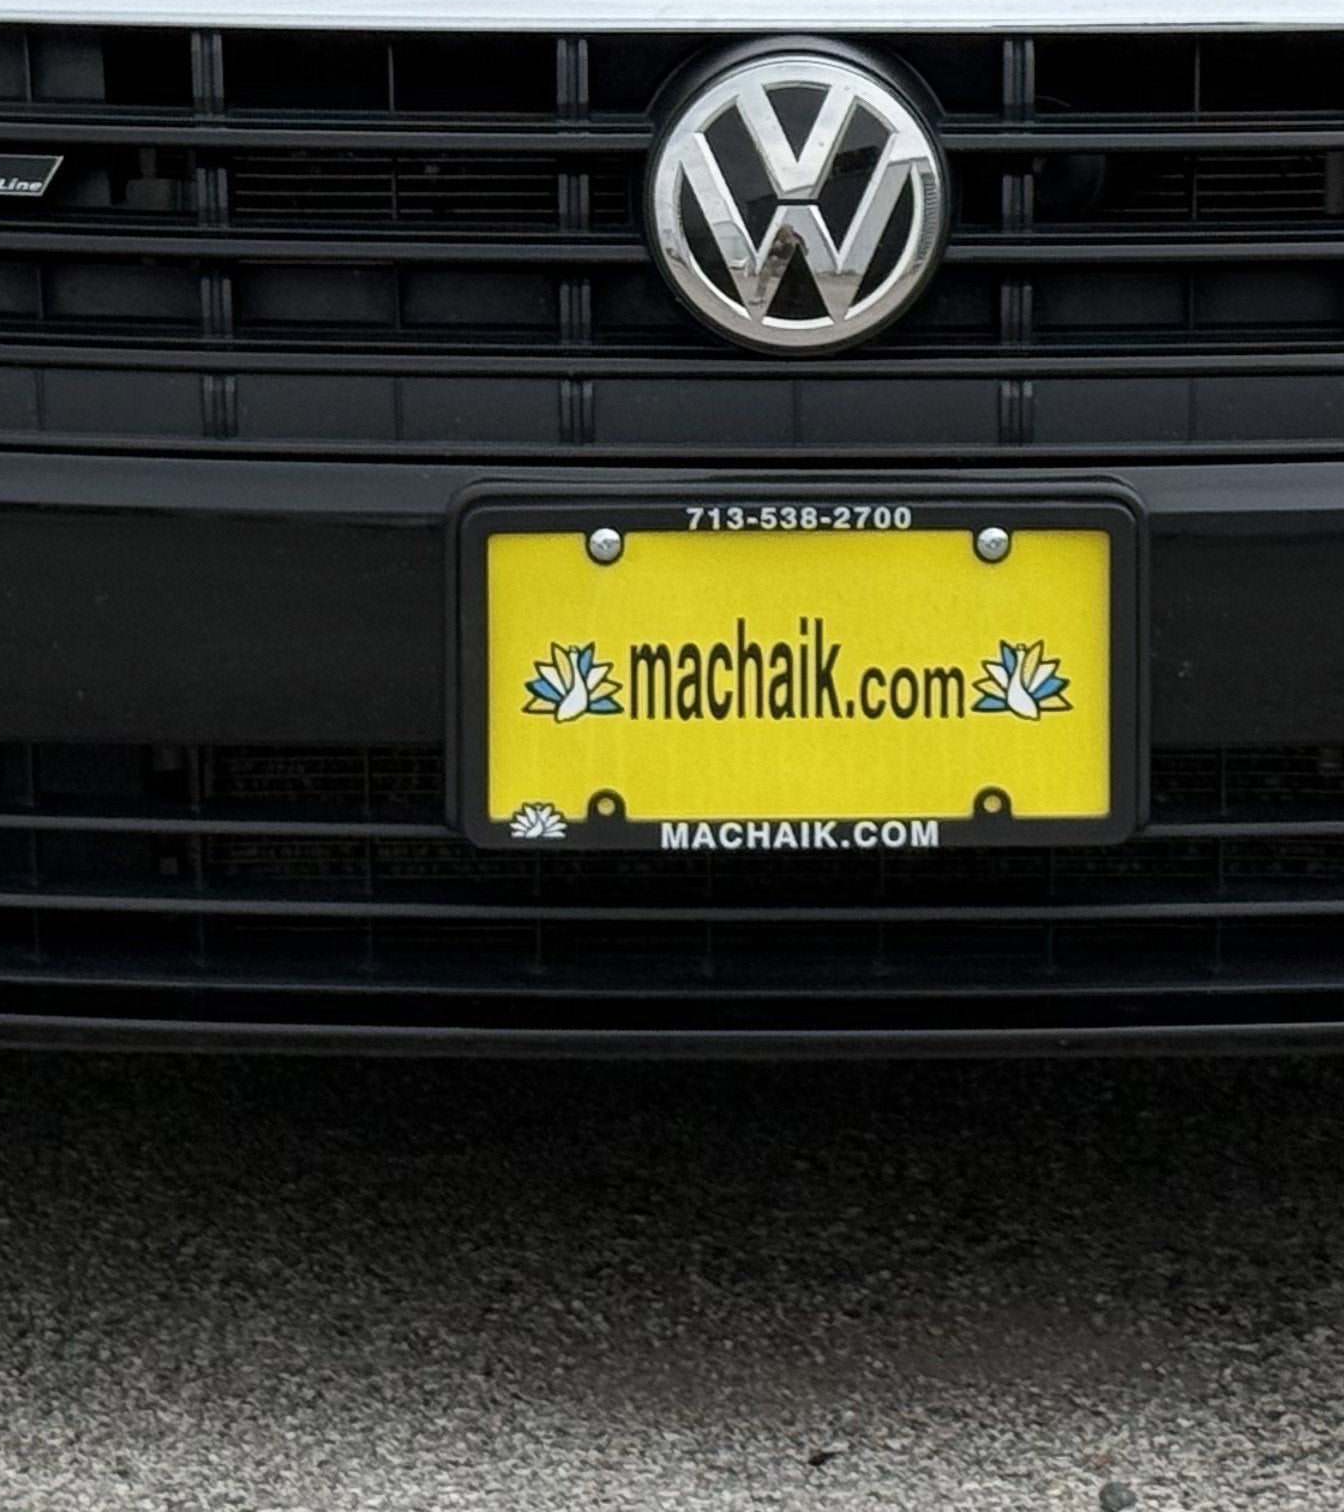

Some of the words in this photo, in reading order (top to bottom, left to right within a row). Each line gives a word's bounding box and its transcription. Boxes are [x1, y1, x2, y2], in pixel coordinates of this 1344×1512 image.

[685, 506, 913, 531] 713-538-2700
[629, 616, 966, 721] machaik.com
[659, 819, 940, 851] MACHAIK.COM
